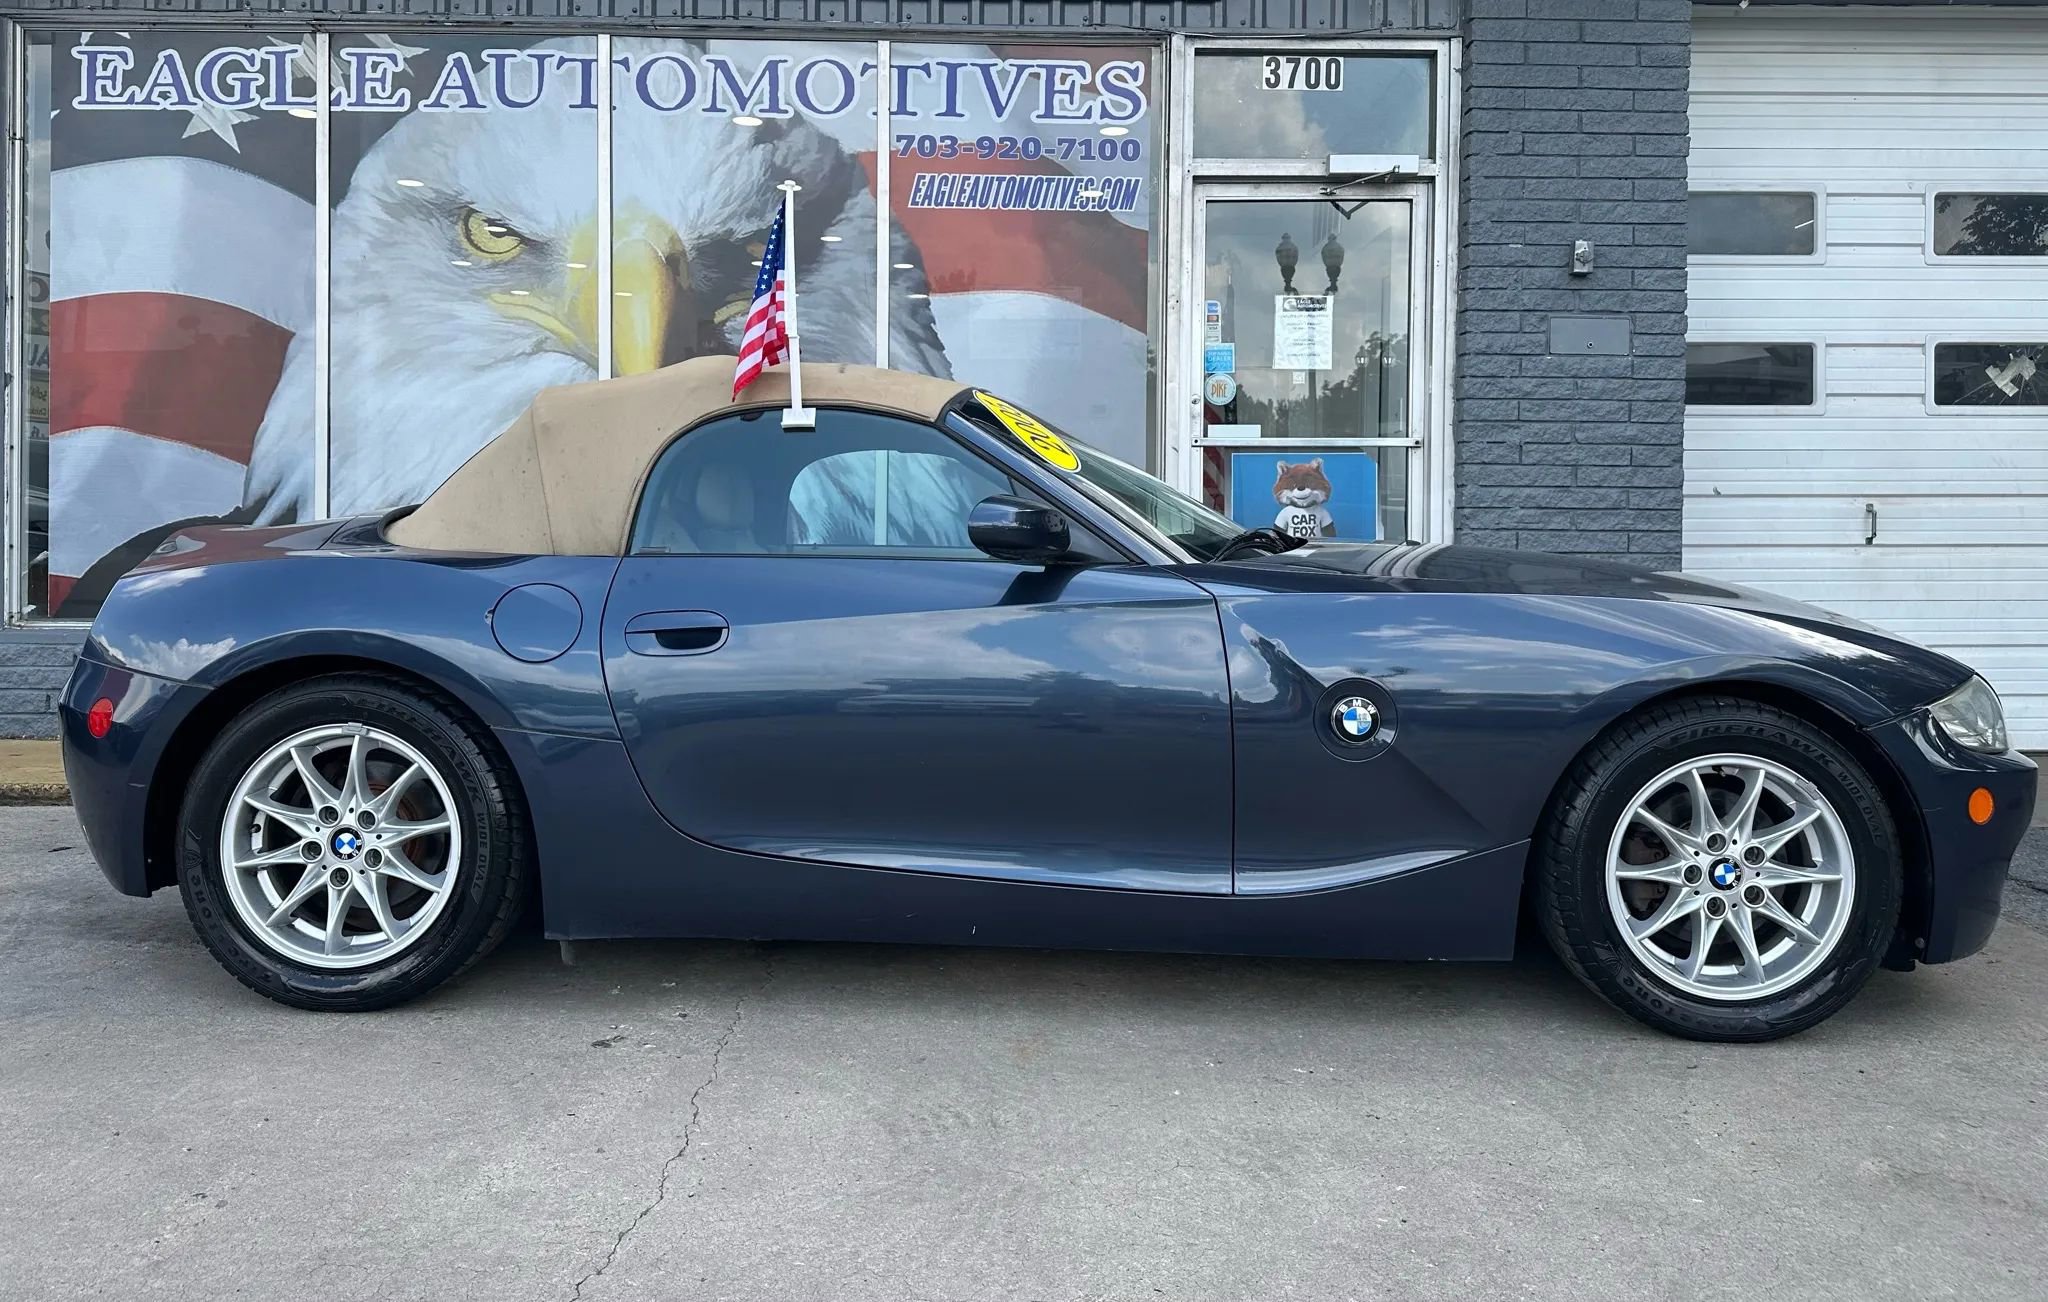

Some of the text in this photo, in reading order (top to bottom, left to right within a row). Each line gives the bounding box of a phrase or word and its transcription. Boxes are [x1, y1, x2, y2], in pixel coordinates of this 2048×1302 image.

[74, 46, 1147, 124] EAGLE AUTOMOTIVES
[1265, 57, 1341, 89] 3700
[896, 134, 1141, 162] 703-920-7100
[908, 174, 1142, 212] EAGLEAUTOMOTIVES.COM
[1211, 383, 1228, 398] PIKE
[1292, 514, 1317, 526] CAR
[1293, 526, 1317, 537] FOX
[1339, 699, 1377, 715] BMW
[1669, 724, 1885, 841] FIREHAWK WIDE OVAL
[476, 812, 490, 849] WIDE
[341, 839, 363, 860] BMW
[472, 853, 490, 892] OVAL
